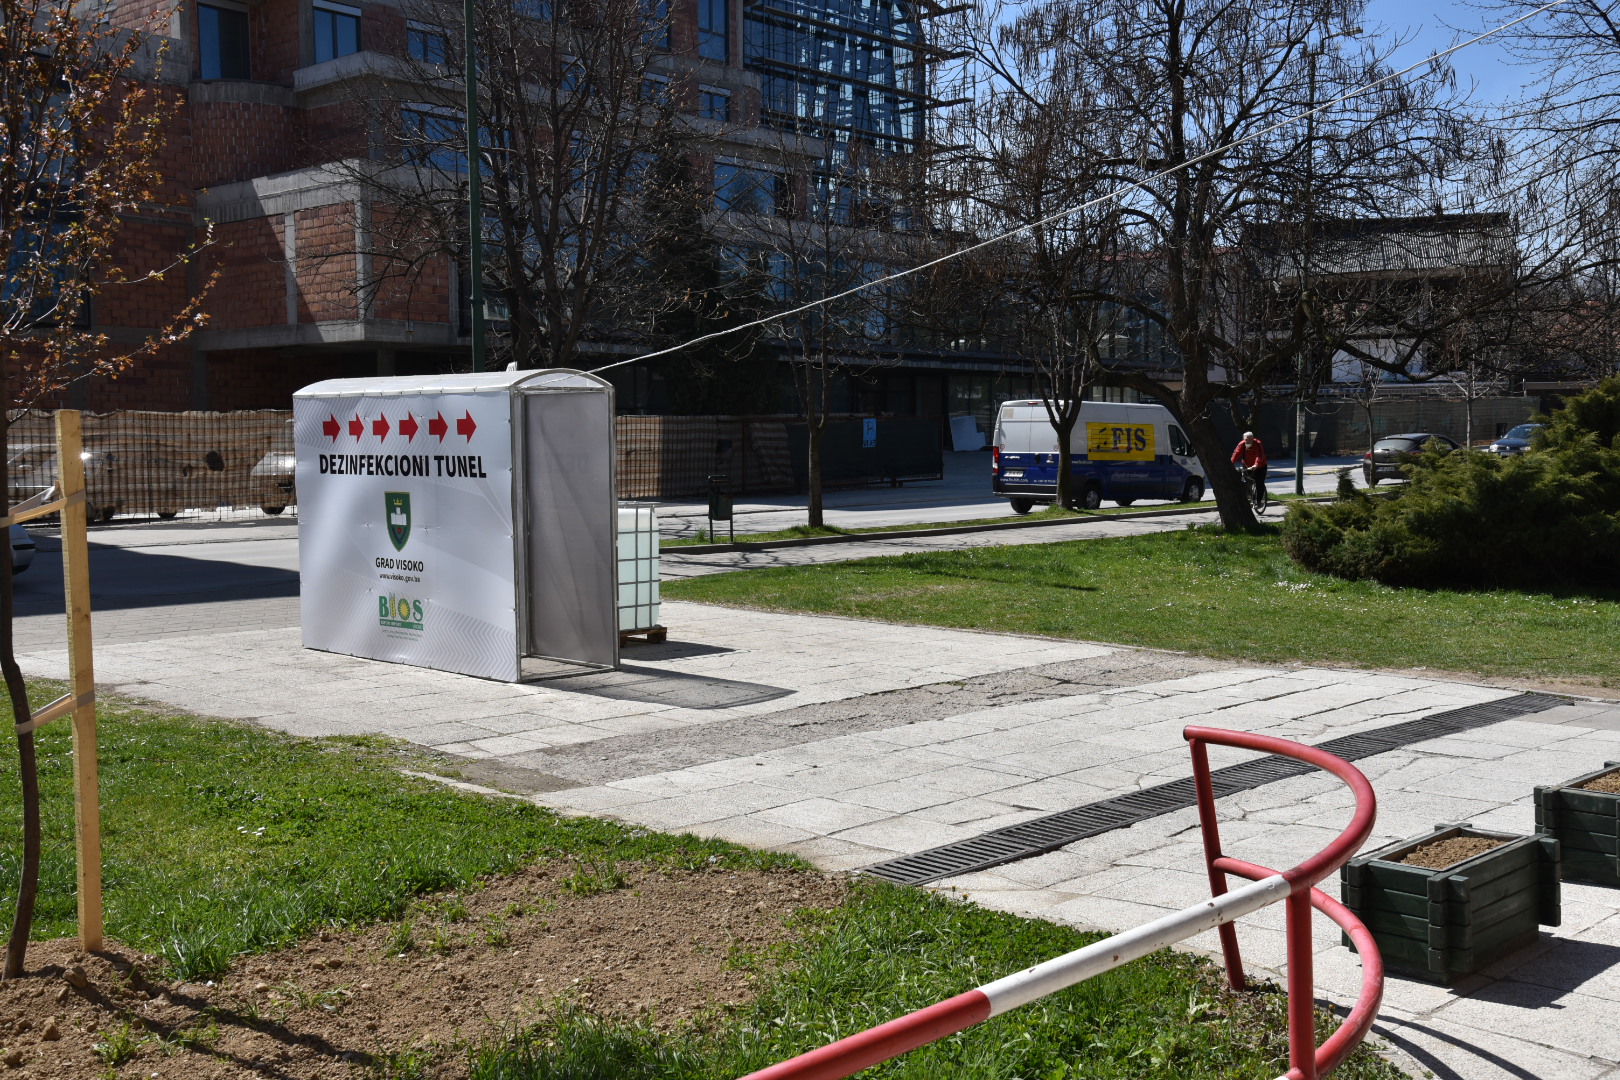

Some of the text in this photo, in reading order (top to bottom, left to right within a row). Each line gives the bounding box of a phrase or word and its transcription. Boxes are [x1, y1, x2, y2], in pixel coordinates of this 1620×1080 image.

[1111, 427, 1147, 452] FIS
[319, 454, 487, 478] DEZINFEKCIONI TUNEL
[375, 557, 424, 572] GRAD VISOKO
[379, 573, 421, 583] www.visoko.gov.ba
